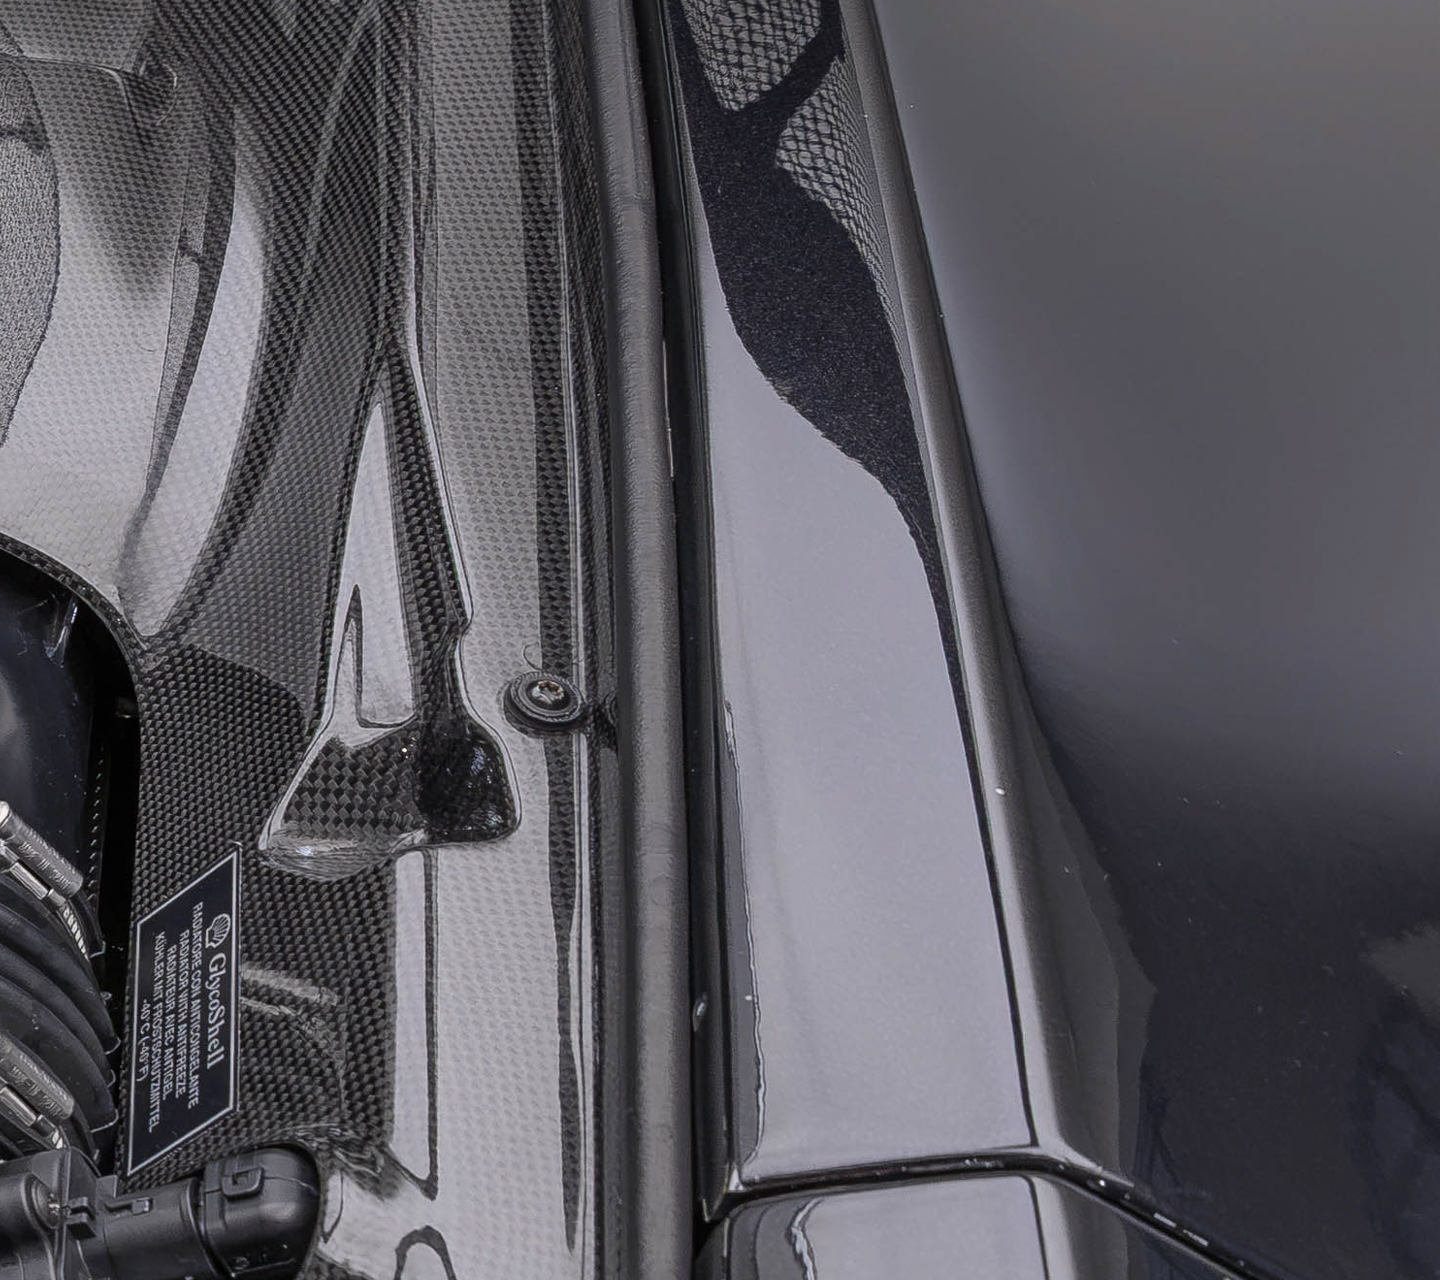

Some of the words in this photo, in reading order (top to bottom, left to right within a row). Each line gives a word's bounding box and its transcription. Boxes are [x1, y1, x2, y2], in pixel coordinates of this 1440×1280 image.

[154, 931, 167, 981] KÜHLER
[178, 929, 189, 990] RADIATOR
[191, 902, 202, 970] RADIATORE
[153, 979, 164, 1001] MIT
[165, 944, 177, 1013] RADIATEUR
[178, 989, 188, 1023] WITH
[191, 969, 201, 998] CON
[164, 1013, 175, 1046] AVEC
[205, 952, 226, 1069] GlycoShell
[149, 1002, 163, 1133] FROSTSCHUTZMITTEL
[162, 1047, 174, 1100] ANTIGEL
[175, 1023, 187, 1098] ANTIFREEZE
[188, 999, 200, 1109] ANTICONGELANTE
